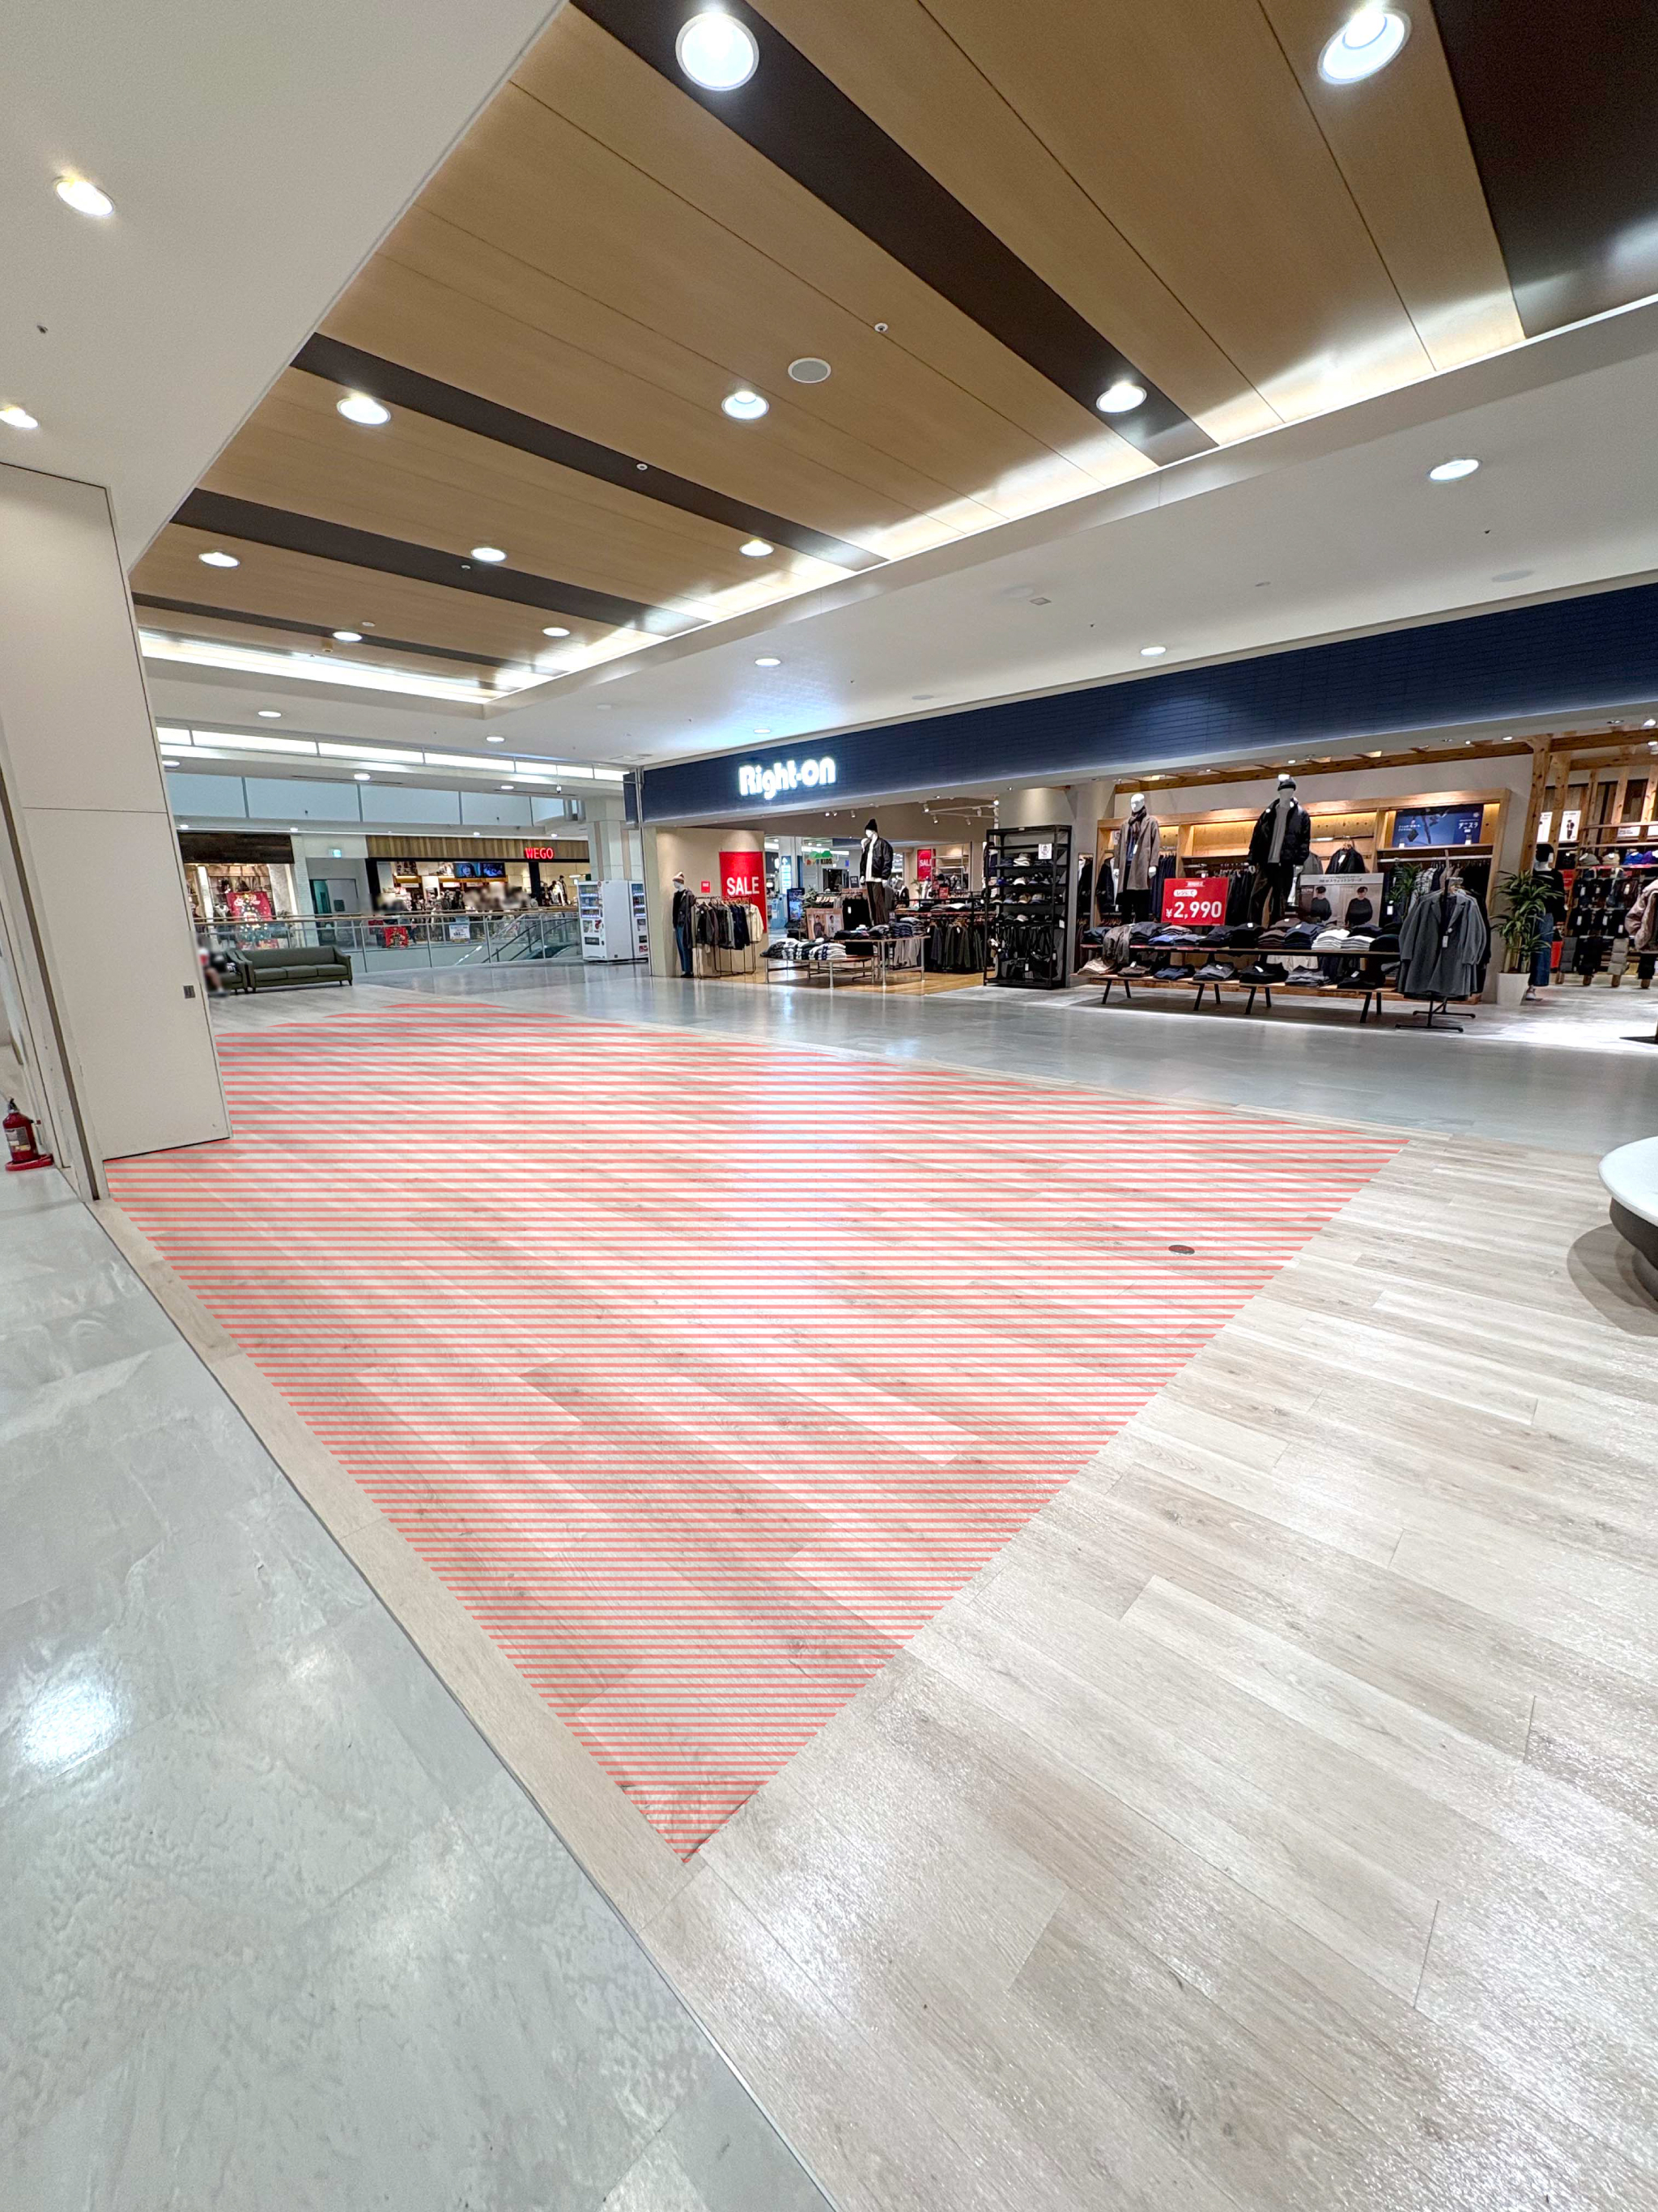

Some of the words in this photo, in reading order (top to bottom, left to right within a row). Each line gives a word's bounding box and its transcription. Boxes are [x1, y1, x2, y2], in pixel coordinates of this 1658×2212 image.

[739, 756, 836, 800] Right-on
[525, 847, 554, 859] WEGO
[726, 876, 759, 895] SALE
[1166, 901, 1222, 919] ¥2,990
